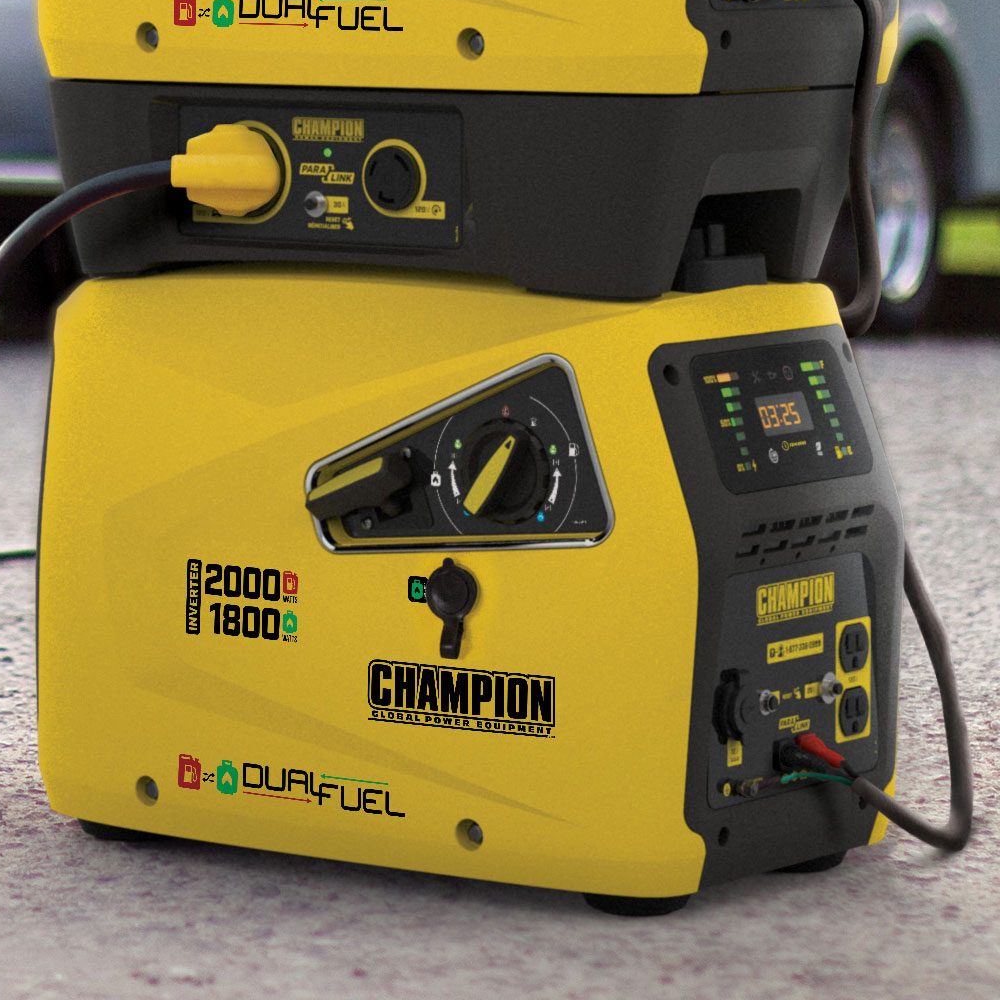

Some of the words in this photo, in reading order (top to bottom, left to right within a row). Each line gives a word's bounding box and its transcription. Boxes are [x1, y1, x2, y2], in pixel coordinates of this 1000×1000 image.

[294, 119, 363, 137] CHAMPION
[302, 165, 326, 173] PARA
[331, 173, 353, 182] LINK
[758, 402, 801, 429] 03:25
[188, 562, 199, 631] INVERTER
[205, 564, 281, 601] 2000
[758, 575, 833, 615] CHAMPION
[209, 602, 281, 640] 1800
[371, 663, 552, 723] CHAMPION
[371, 710, 421, 722] GLOBAL
[425, 715, 470, 727] POWER
[476, 721, 552, 735] EQUIPMENT
